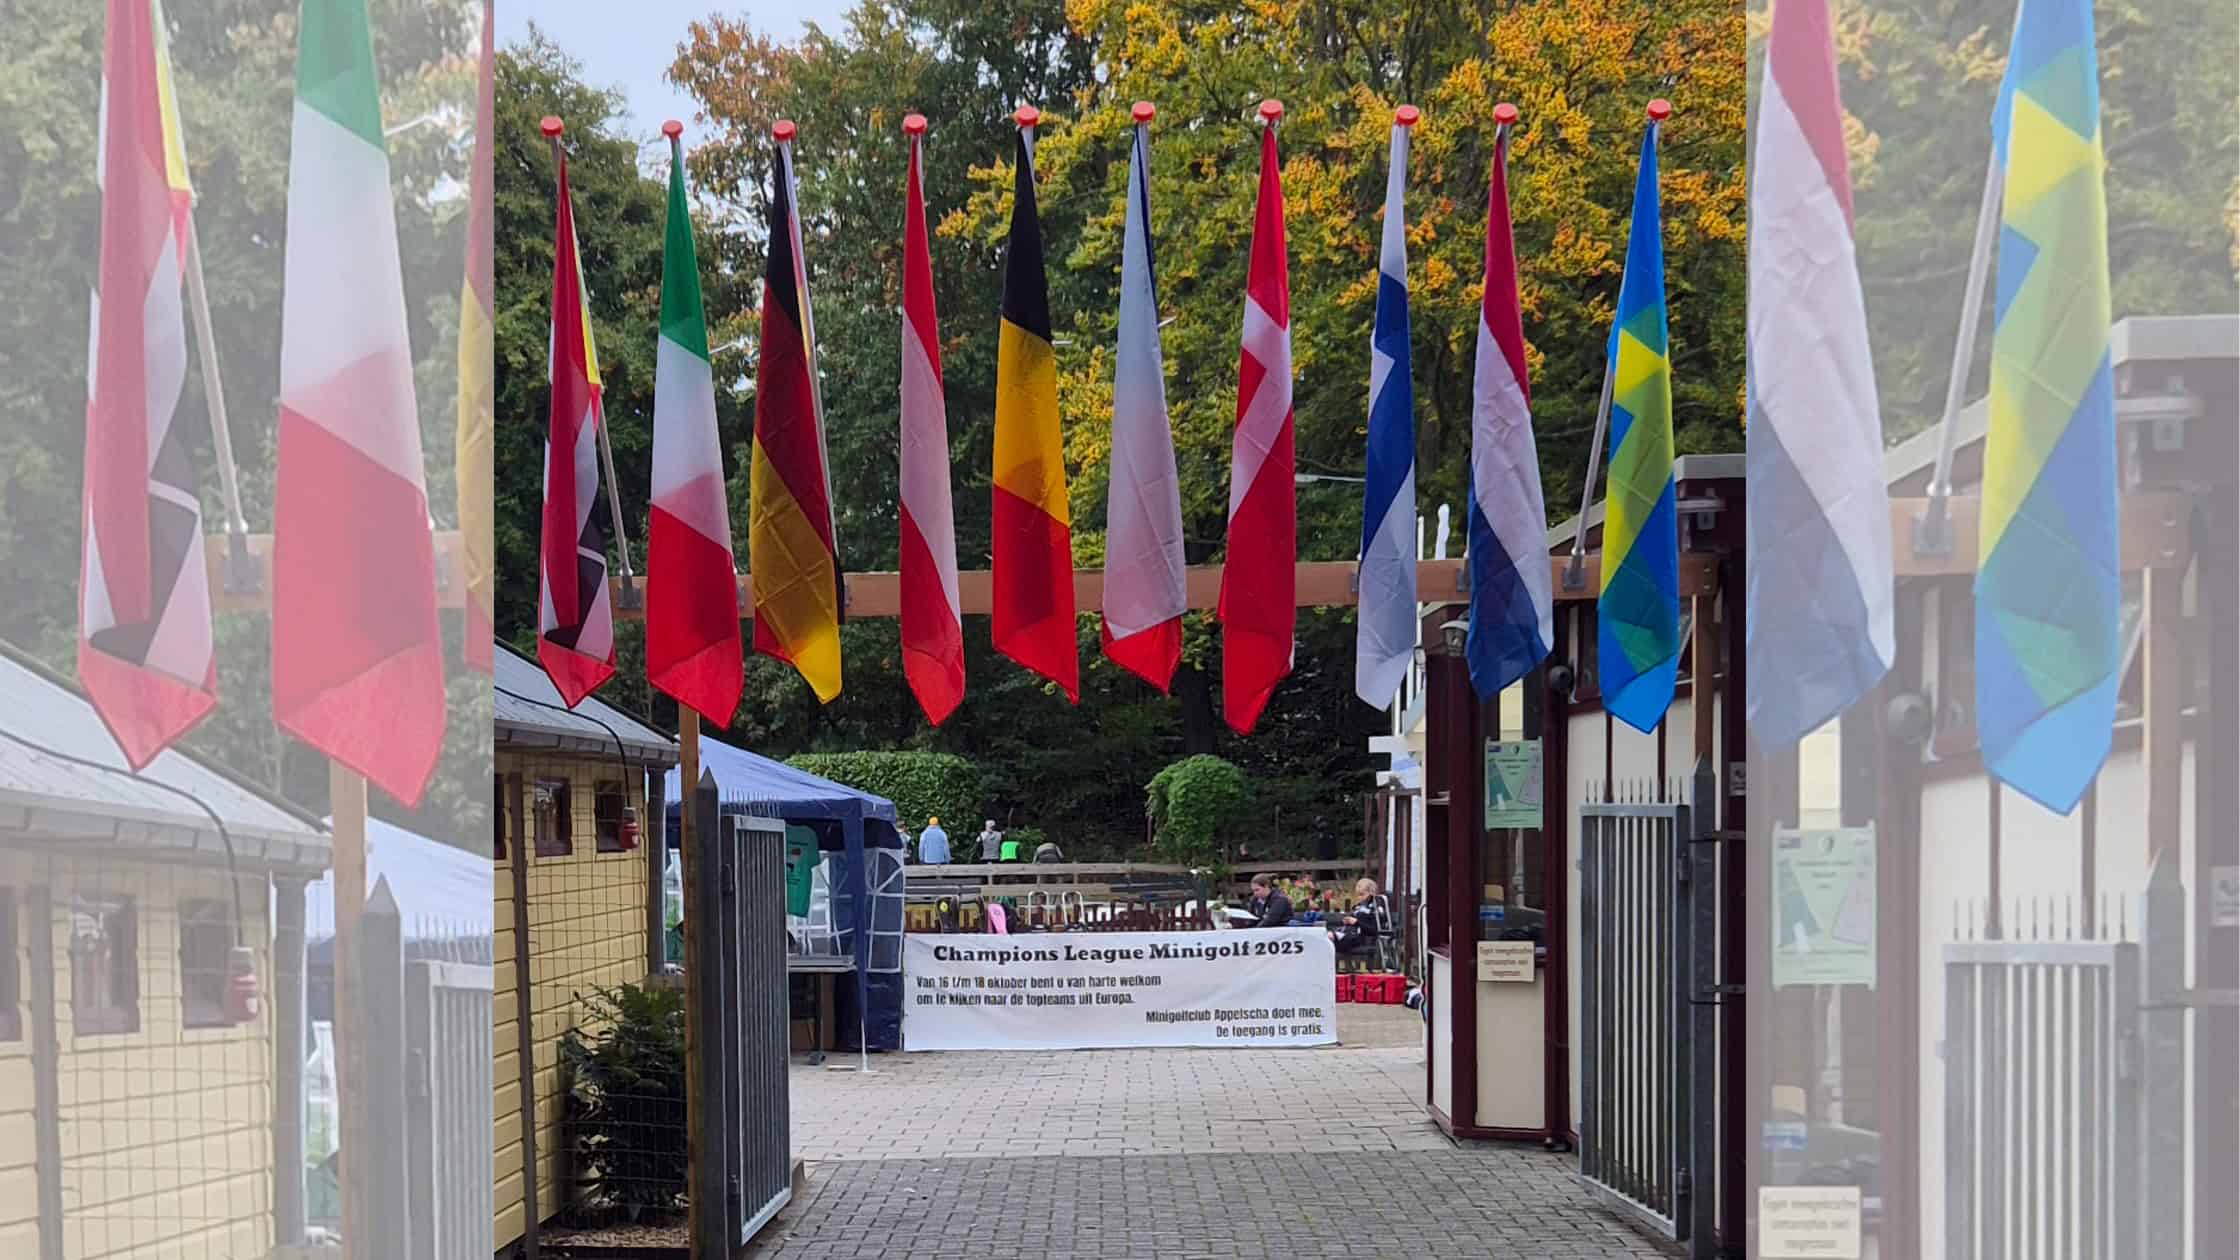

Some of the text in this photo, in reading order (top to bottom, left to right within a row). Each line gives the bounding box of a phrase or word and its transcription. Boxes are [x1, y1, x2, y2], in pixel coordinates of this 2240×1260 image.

[934, 941, 1304, 964] Champions League Minigolf 2025
[916, 975, 1161, 988] Van 16 t/m 18 oktober bent u van harte welkom
[916, 992, 1135, 1006] om te kijken naar de topteams uit Europa.
[1146, 1007, 1325, 1024] Minigolfclub Appelscha doet mee.
[1216, 1023, 1325, 1038] De toegang is gratis.
